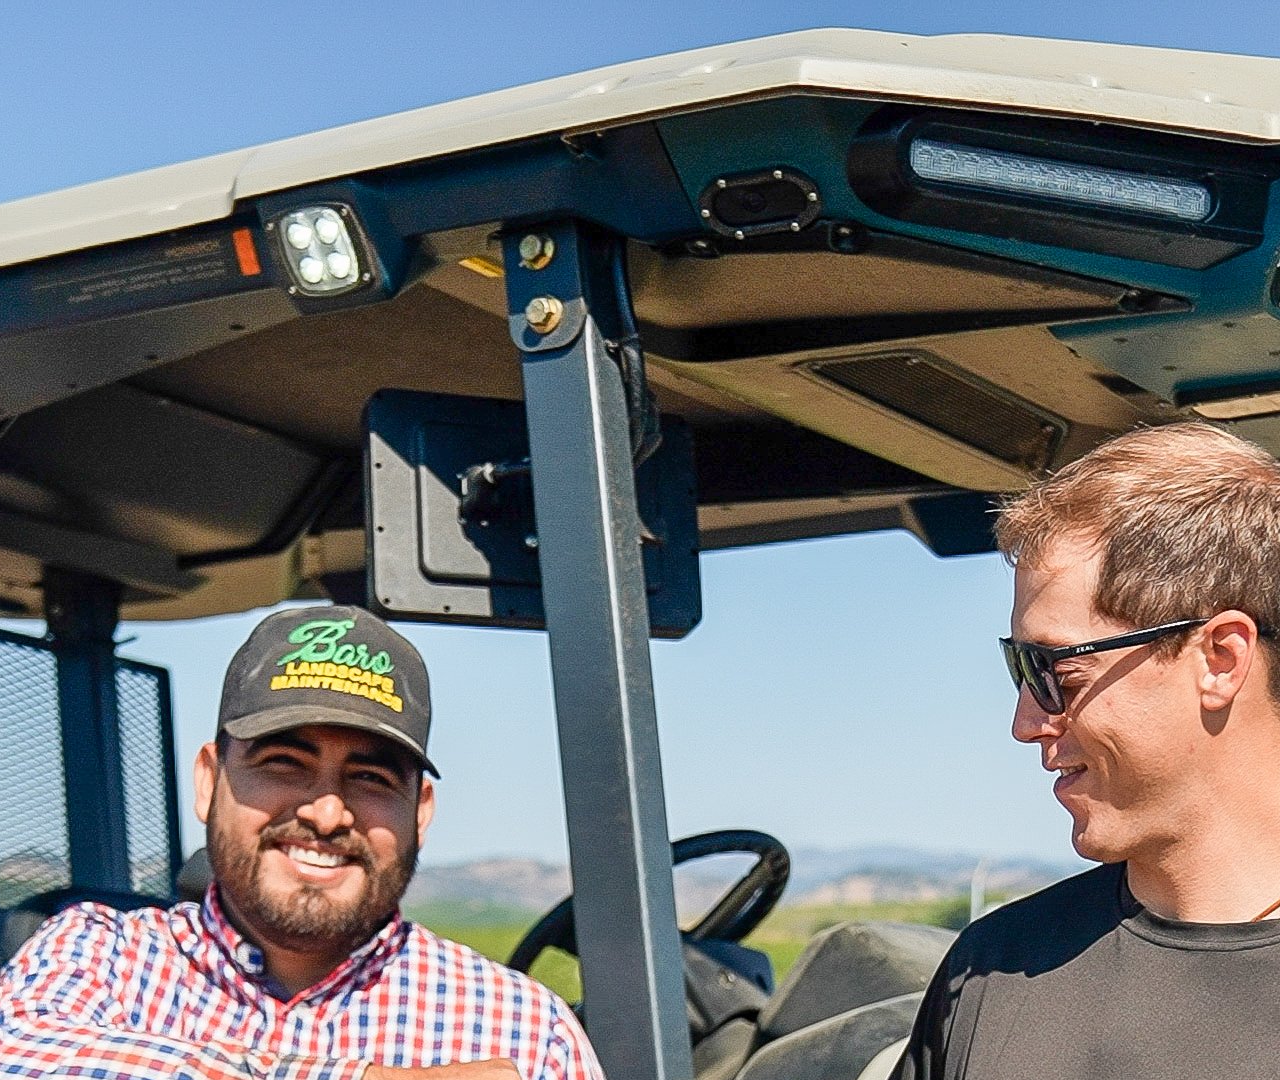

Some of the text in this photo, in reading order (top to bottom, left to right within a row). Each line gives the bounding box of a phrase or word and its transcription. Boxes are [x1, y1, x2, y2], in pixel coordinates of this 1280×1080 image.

[277, 619, 395, 675] Baro
[270, 675, 403, 713] MAINTENANCE
[285, 661, 395, 694] LANDSCAPE
